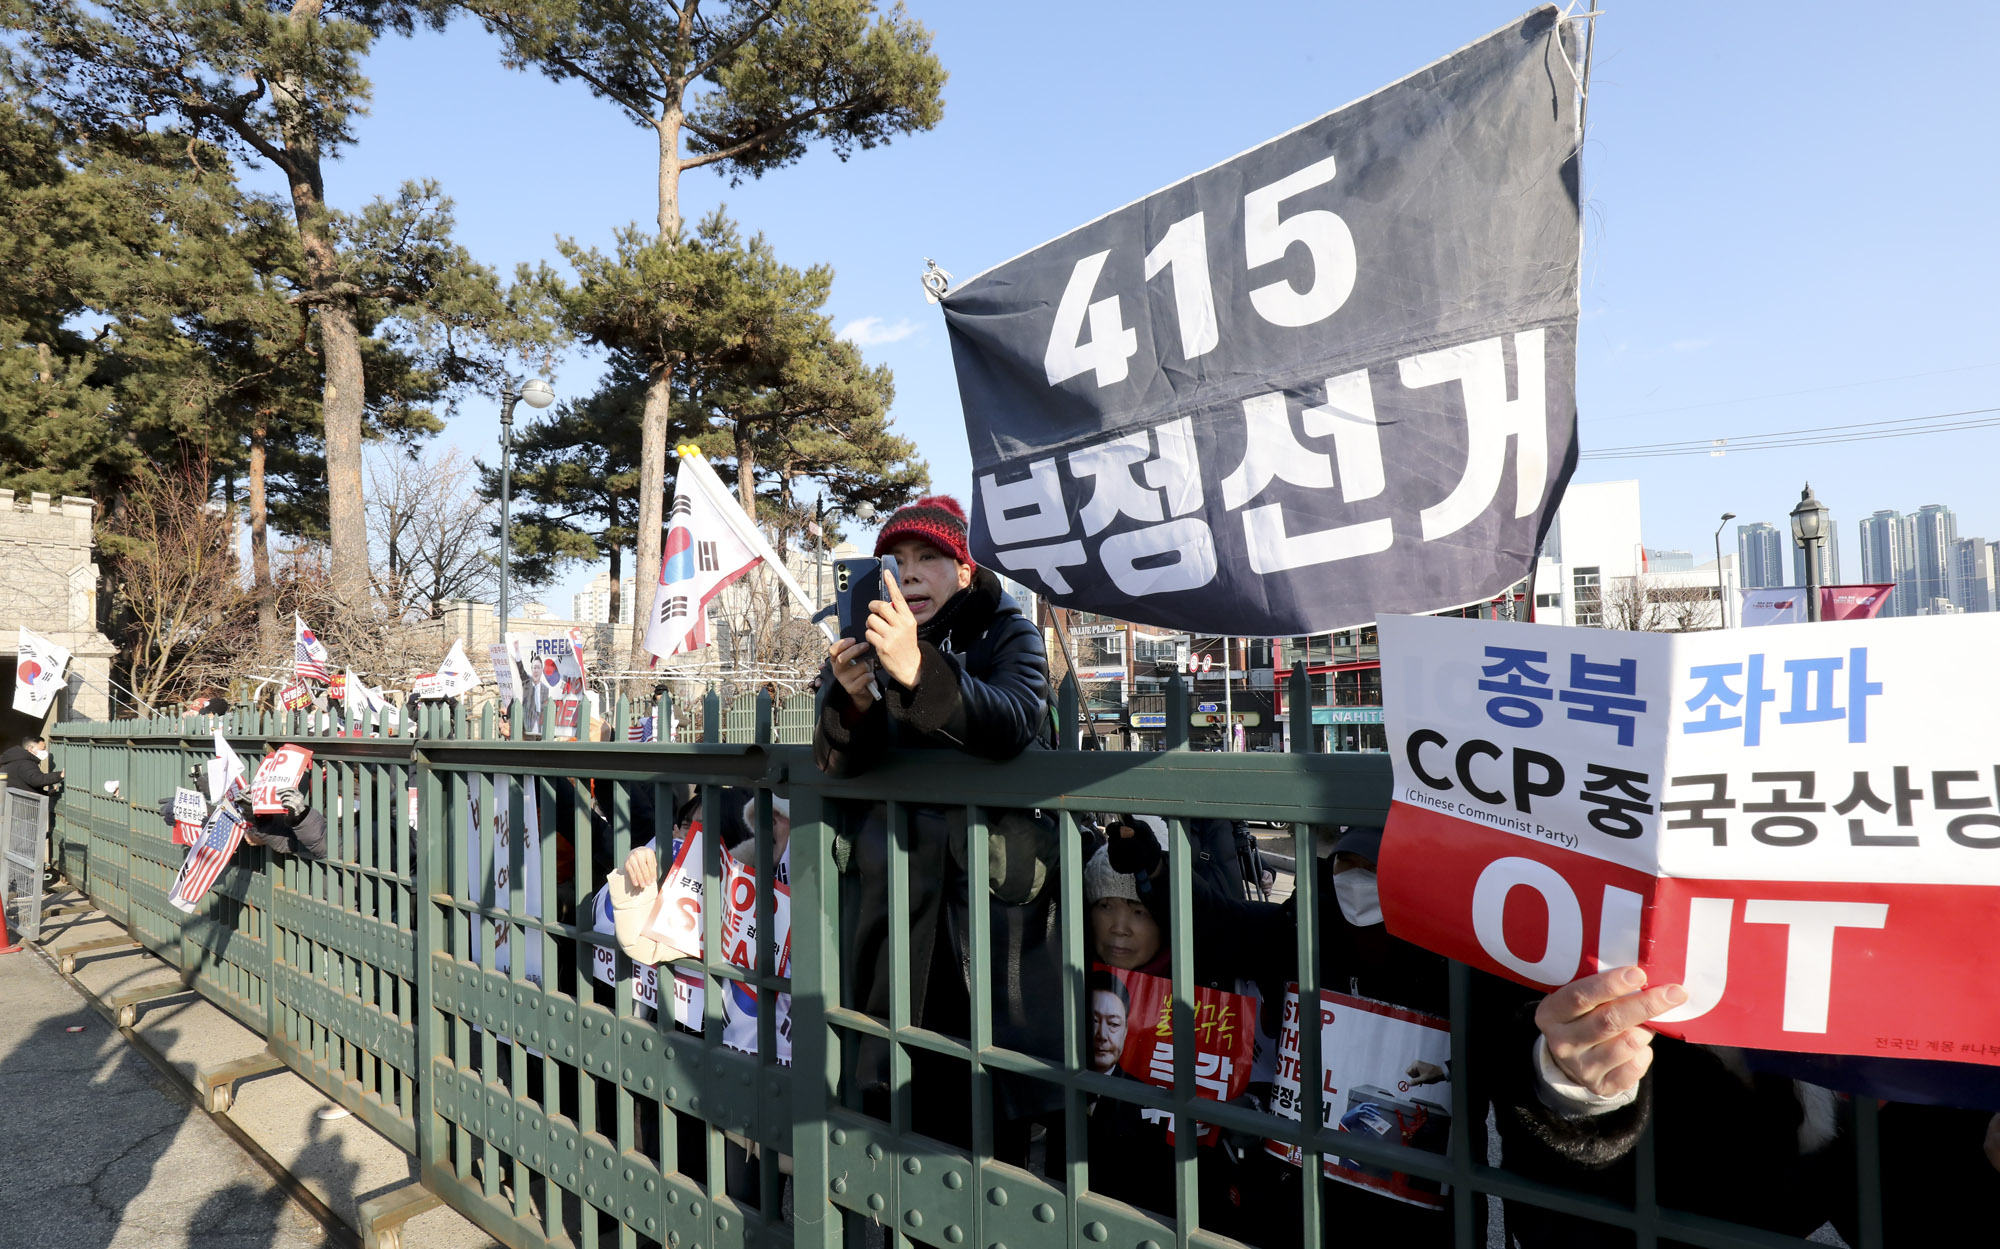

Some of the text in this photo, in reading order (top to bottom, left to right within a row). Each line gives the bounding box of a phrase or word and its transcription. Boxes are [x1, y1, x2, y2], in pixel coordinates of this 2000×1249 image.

[1043, 155, 1357, 388] 415
[979, 328, 1548, 597] 부정선거
[1070, 626, 1091, 635] VALUE
[1092, 624, 1116, 634] PLACE
[1478, 645, 1883, 747] 종북 좌파
[1405, 787, 1579, 848] (Chinese Communist Party)
[1406, 729, 2000, 849] CCP 중국공산당
[592, 945, 613, 965] TOP
[1472, 856, 1889, 1034] OUT
[1155, 994, 1236, 1050] 불구속
[1284, 1000, 1336, 1031] STP
[1875, 1037, 1919, 1050] 전국민
[1275, 1054, 1338, 1095] STEL
